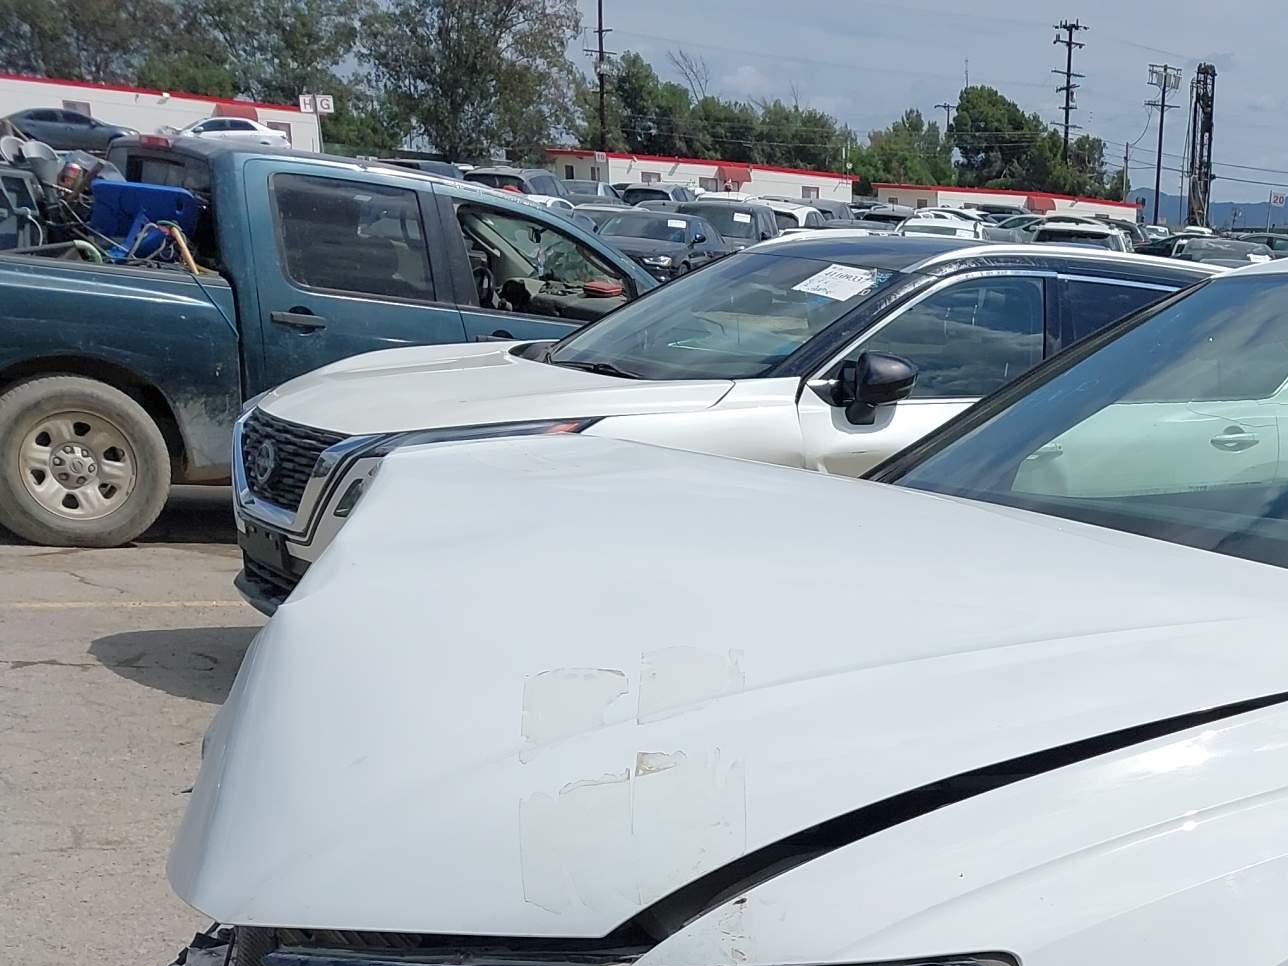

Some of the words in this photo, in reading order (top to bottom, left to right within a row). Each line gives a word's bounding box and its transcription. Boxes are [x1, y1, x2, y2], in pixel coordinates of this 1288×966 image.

[304, 97, 313, 110] H
[320, 97, 331, 110] G
[1273, 195, 1284, 205] 20
